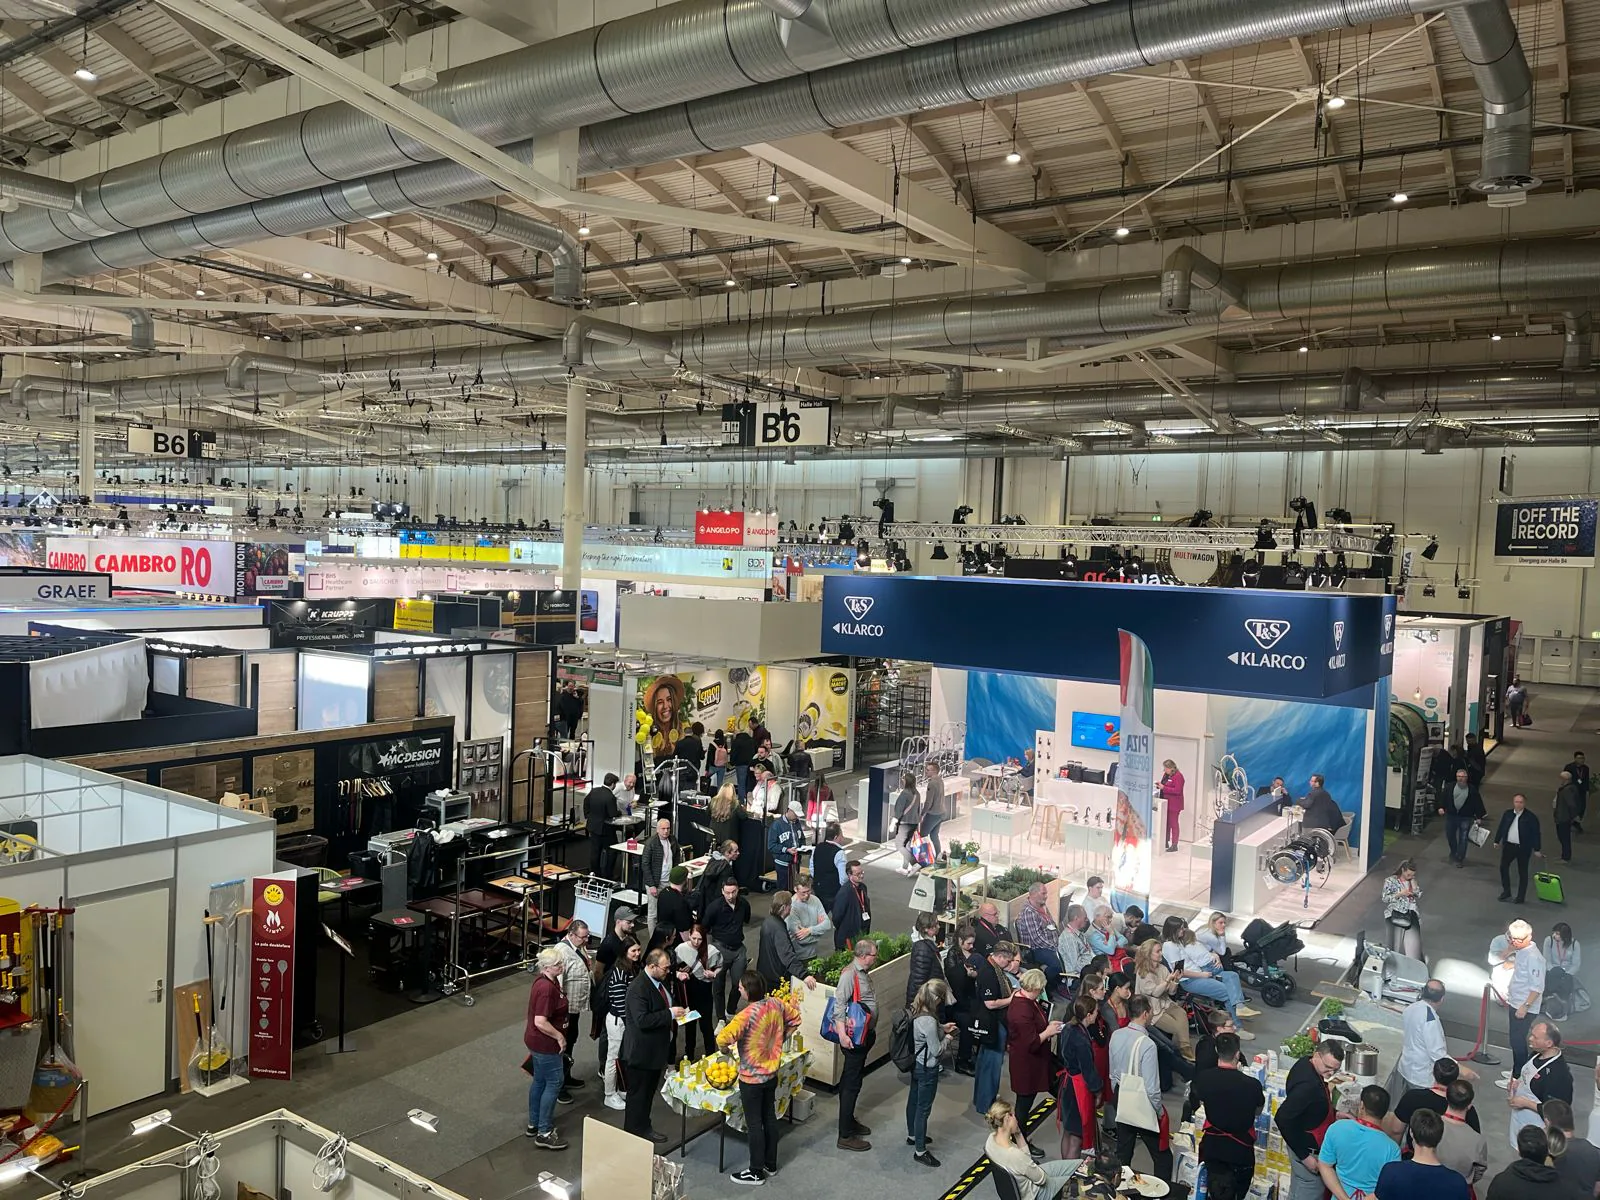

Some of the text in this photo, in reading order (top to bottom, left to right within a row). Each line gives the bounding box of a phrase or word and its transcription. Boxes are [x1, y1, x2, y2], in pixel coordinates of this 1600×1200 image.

[762, 412, 800, 443] B6
[154, 432, 185, 455] B6
[1520, 506, 1580, 523] OFF THE
[1518, 524, 1579, 540] RECORD
[48, 551, 86, 572] CAMBRO
[95, 554, 176, 572] CAMBRO
[1174, 551, 1215, 562] MULTIWAGON
[236, 544, 246, 596] MOIN MOIN
[848, 598, 868, 613] T&S
[841, 622, 884, 636] KLARCO
[1252, 622, 1280, 640] T&S
[1241, 652, 1305, 670] KLARCO
